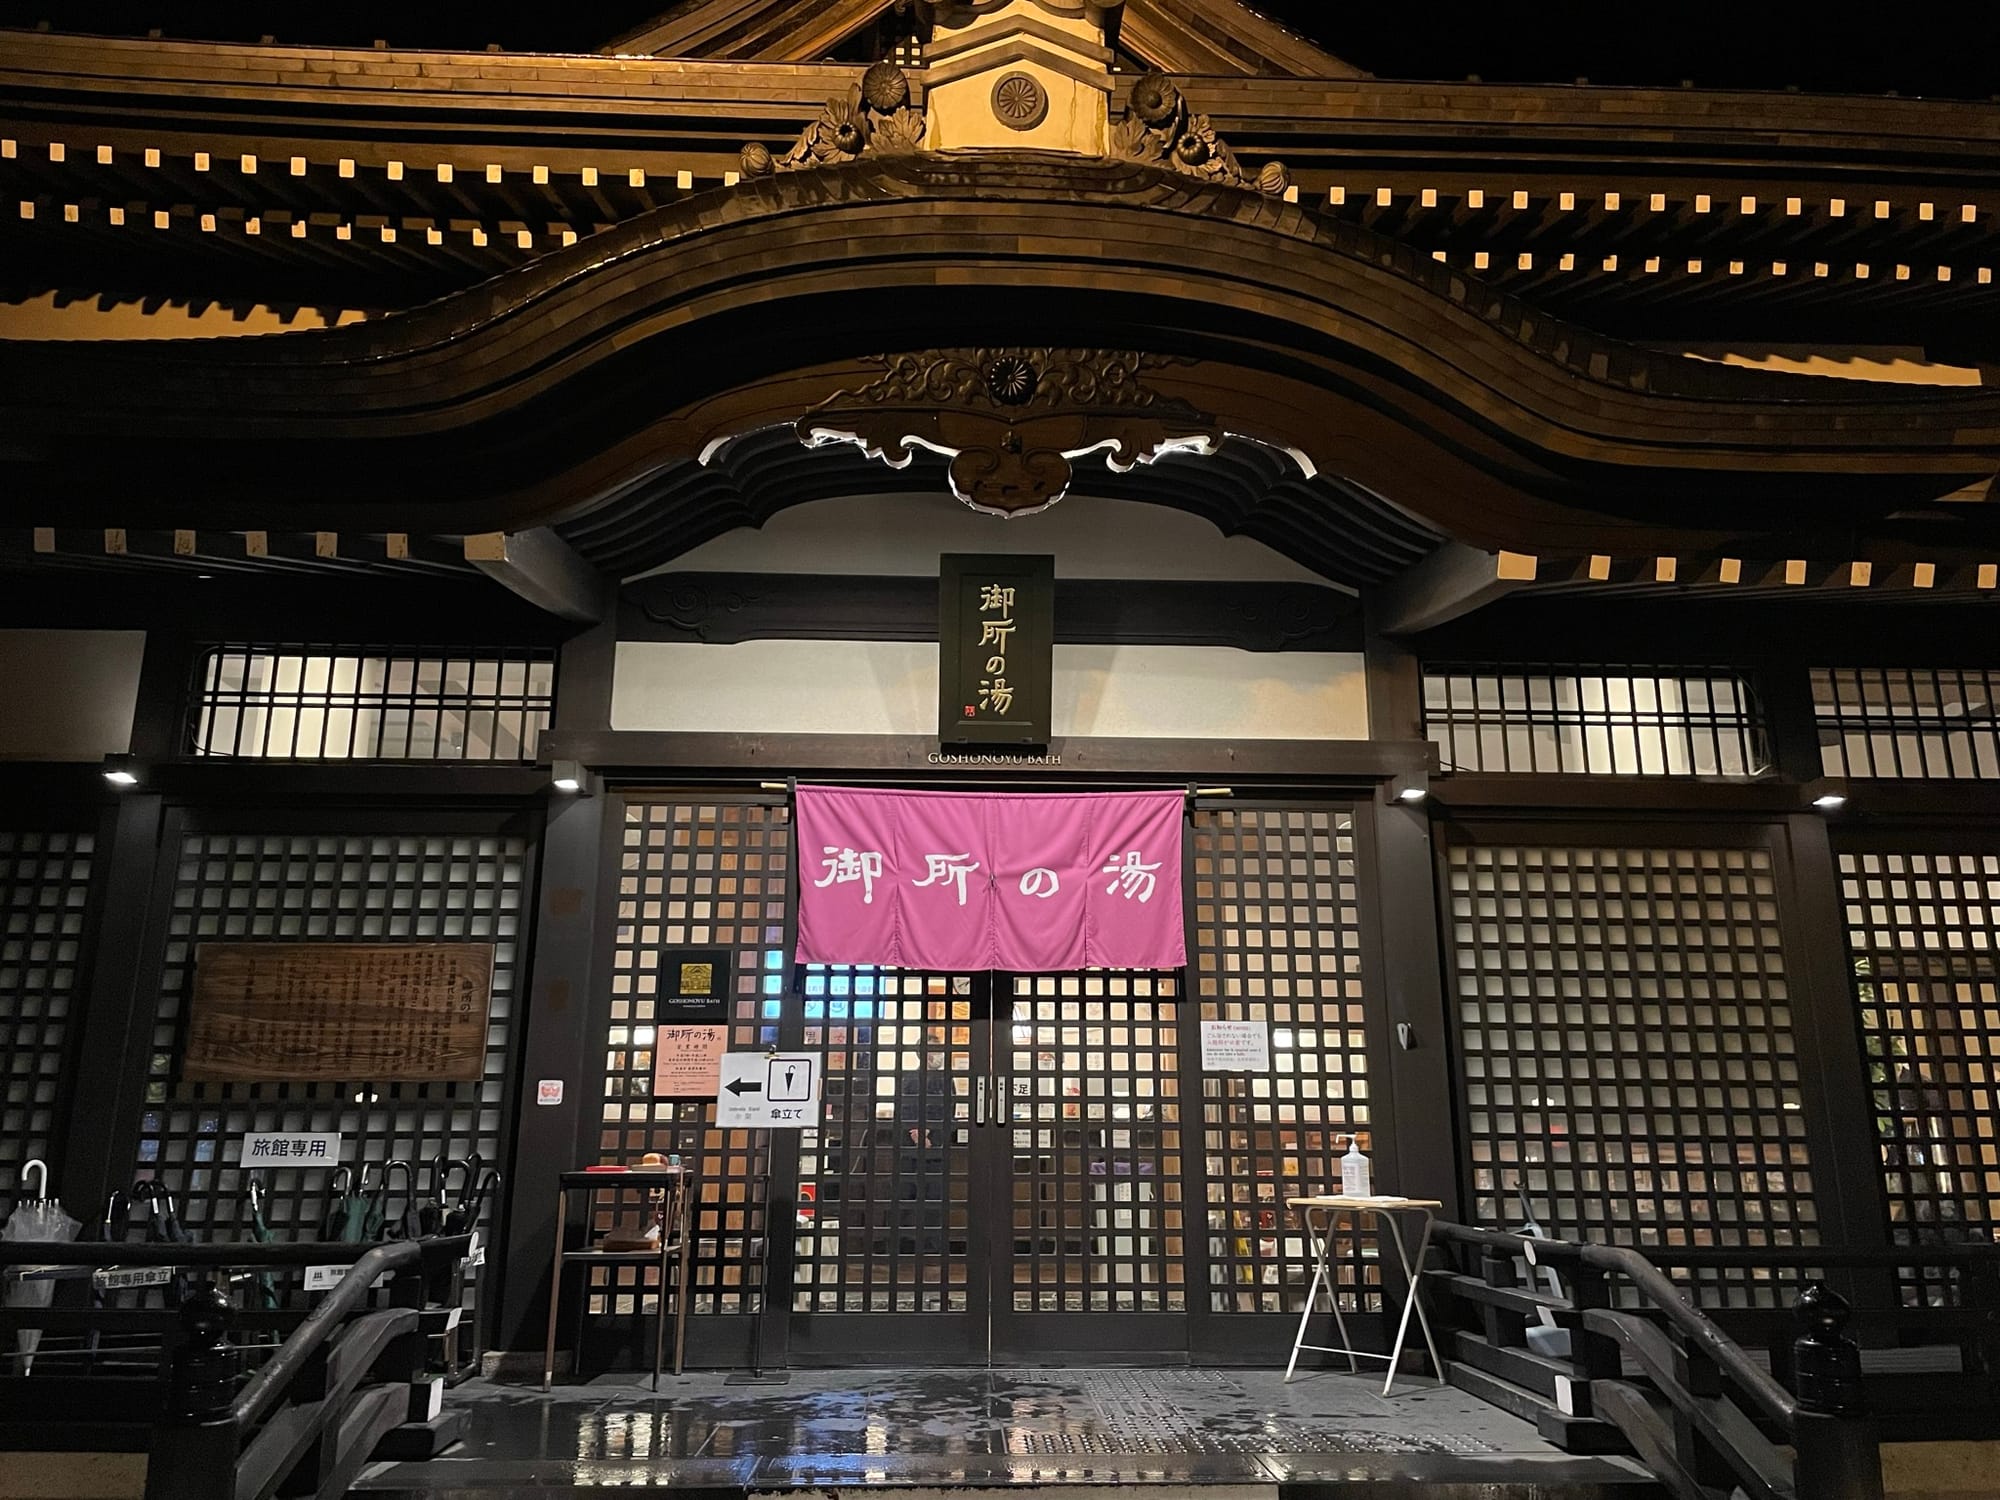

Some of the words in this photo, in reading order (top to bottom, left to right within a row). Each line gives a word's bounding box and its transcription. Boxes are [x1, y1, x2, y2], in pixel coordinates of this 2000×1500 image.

[977, 583, 1016, 716] 御所の湯
[927, 752, 1023, 765] GOSHONOYU
[1027, 754, 1061, 766] BATH
[814, 846, 1162, 906] 御所の湯
[666, 1028, 716, 1042] 御所の湯
[770, 1108, 803, 1119] 傘立て
[251, 1138, 326, 1158] 旅館専用
